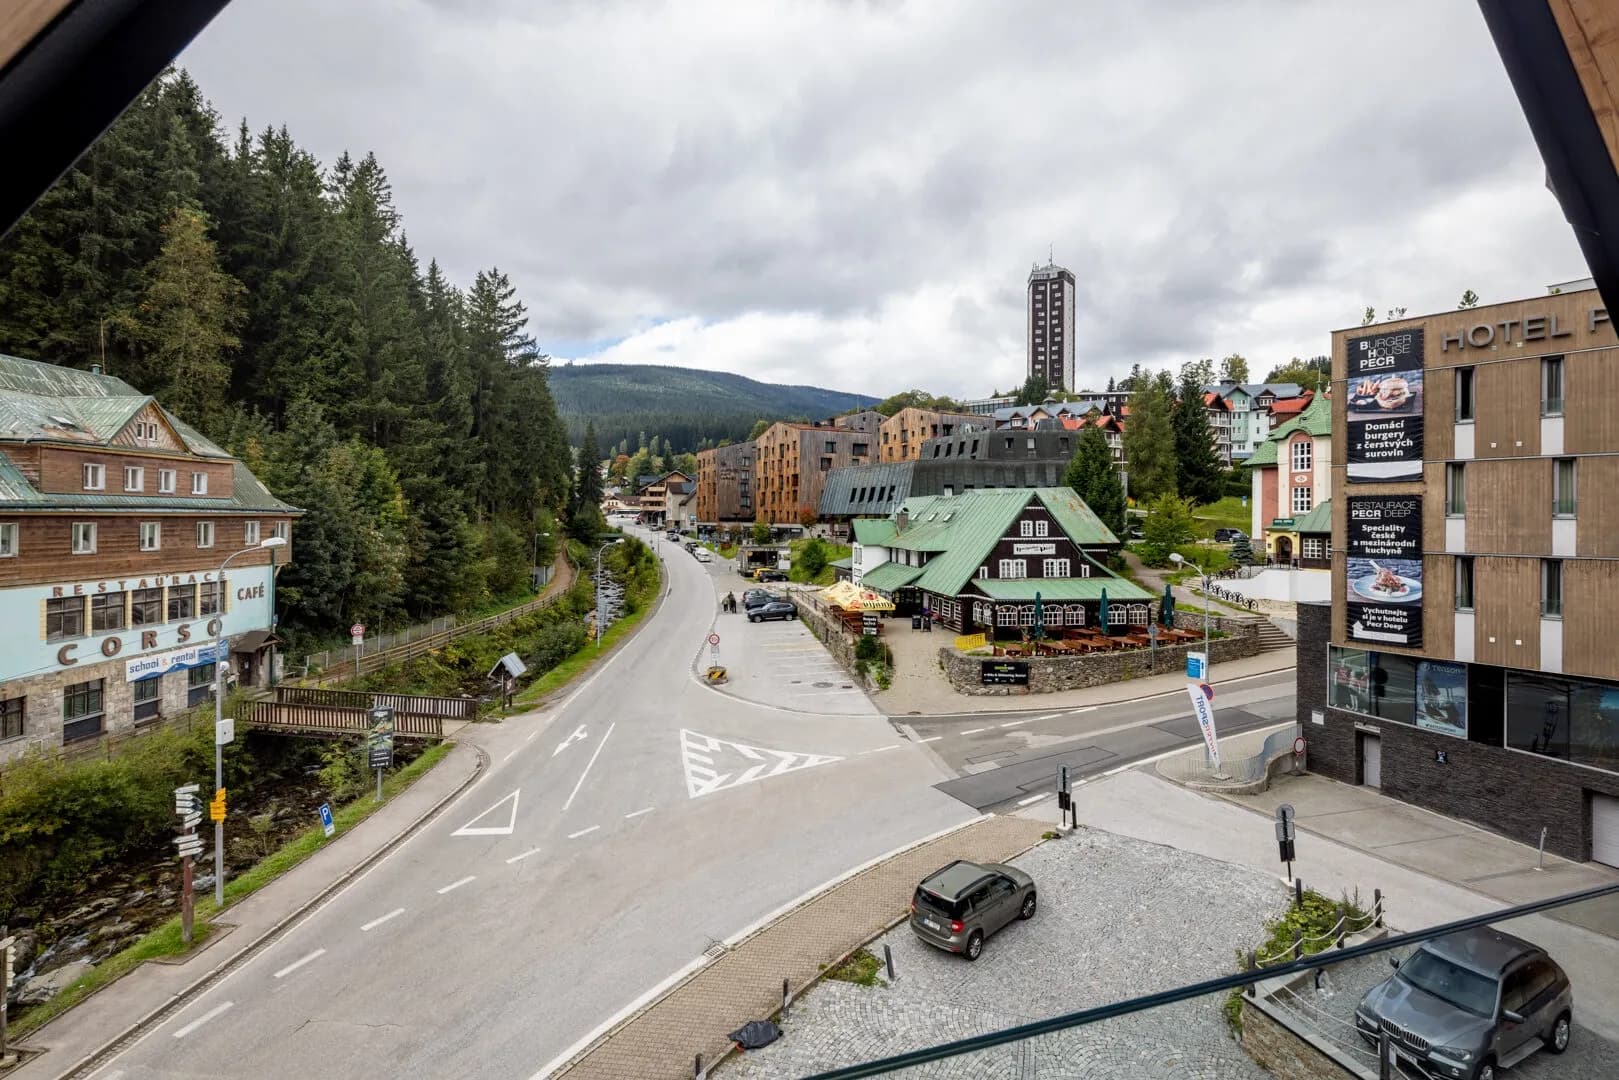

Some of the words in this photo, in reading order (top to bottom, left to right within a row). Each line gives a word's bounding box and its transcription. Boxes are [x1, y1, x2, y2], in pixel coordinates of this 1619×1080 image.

[1442, 314, 1571, 351] HOTEL
[1360, 335, 1411, 350] BURGER
[1368, 344, 1410, 358] HOUSE
[1360, 356, 1395, 369] PECR
[1365, 420, 1405, 430] Domácí
[1364, 431, 1404, 440] burgery
[1364, 438, 1413, 449] čerstvých
[1365, 449, 1404, 458] surovin
[1352, 501, 1416, 510] RESTAURACE
[1362, 524, 1406, 533] Speciality
[1360, 539, 1416, 547] mezinárodní
[1365, 546, 1402, 555] kuchyně
[53, 572, 226, 597] RESTAURACE
[237, 582, 264, 600] CAFÉ
[1362, 607, 1408, 616] Vychutnejte
[1383, 615, 1408, 623] hotelu
[1383, 622, 1403, 630] Deep
[58, 619, 222, 666] CORSO
[130, 657, 159, 674] school
[171, 649, 196, 664] rental
